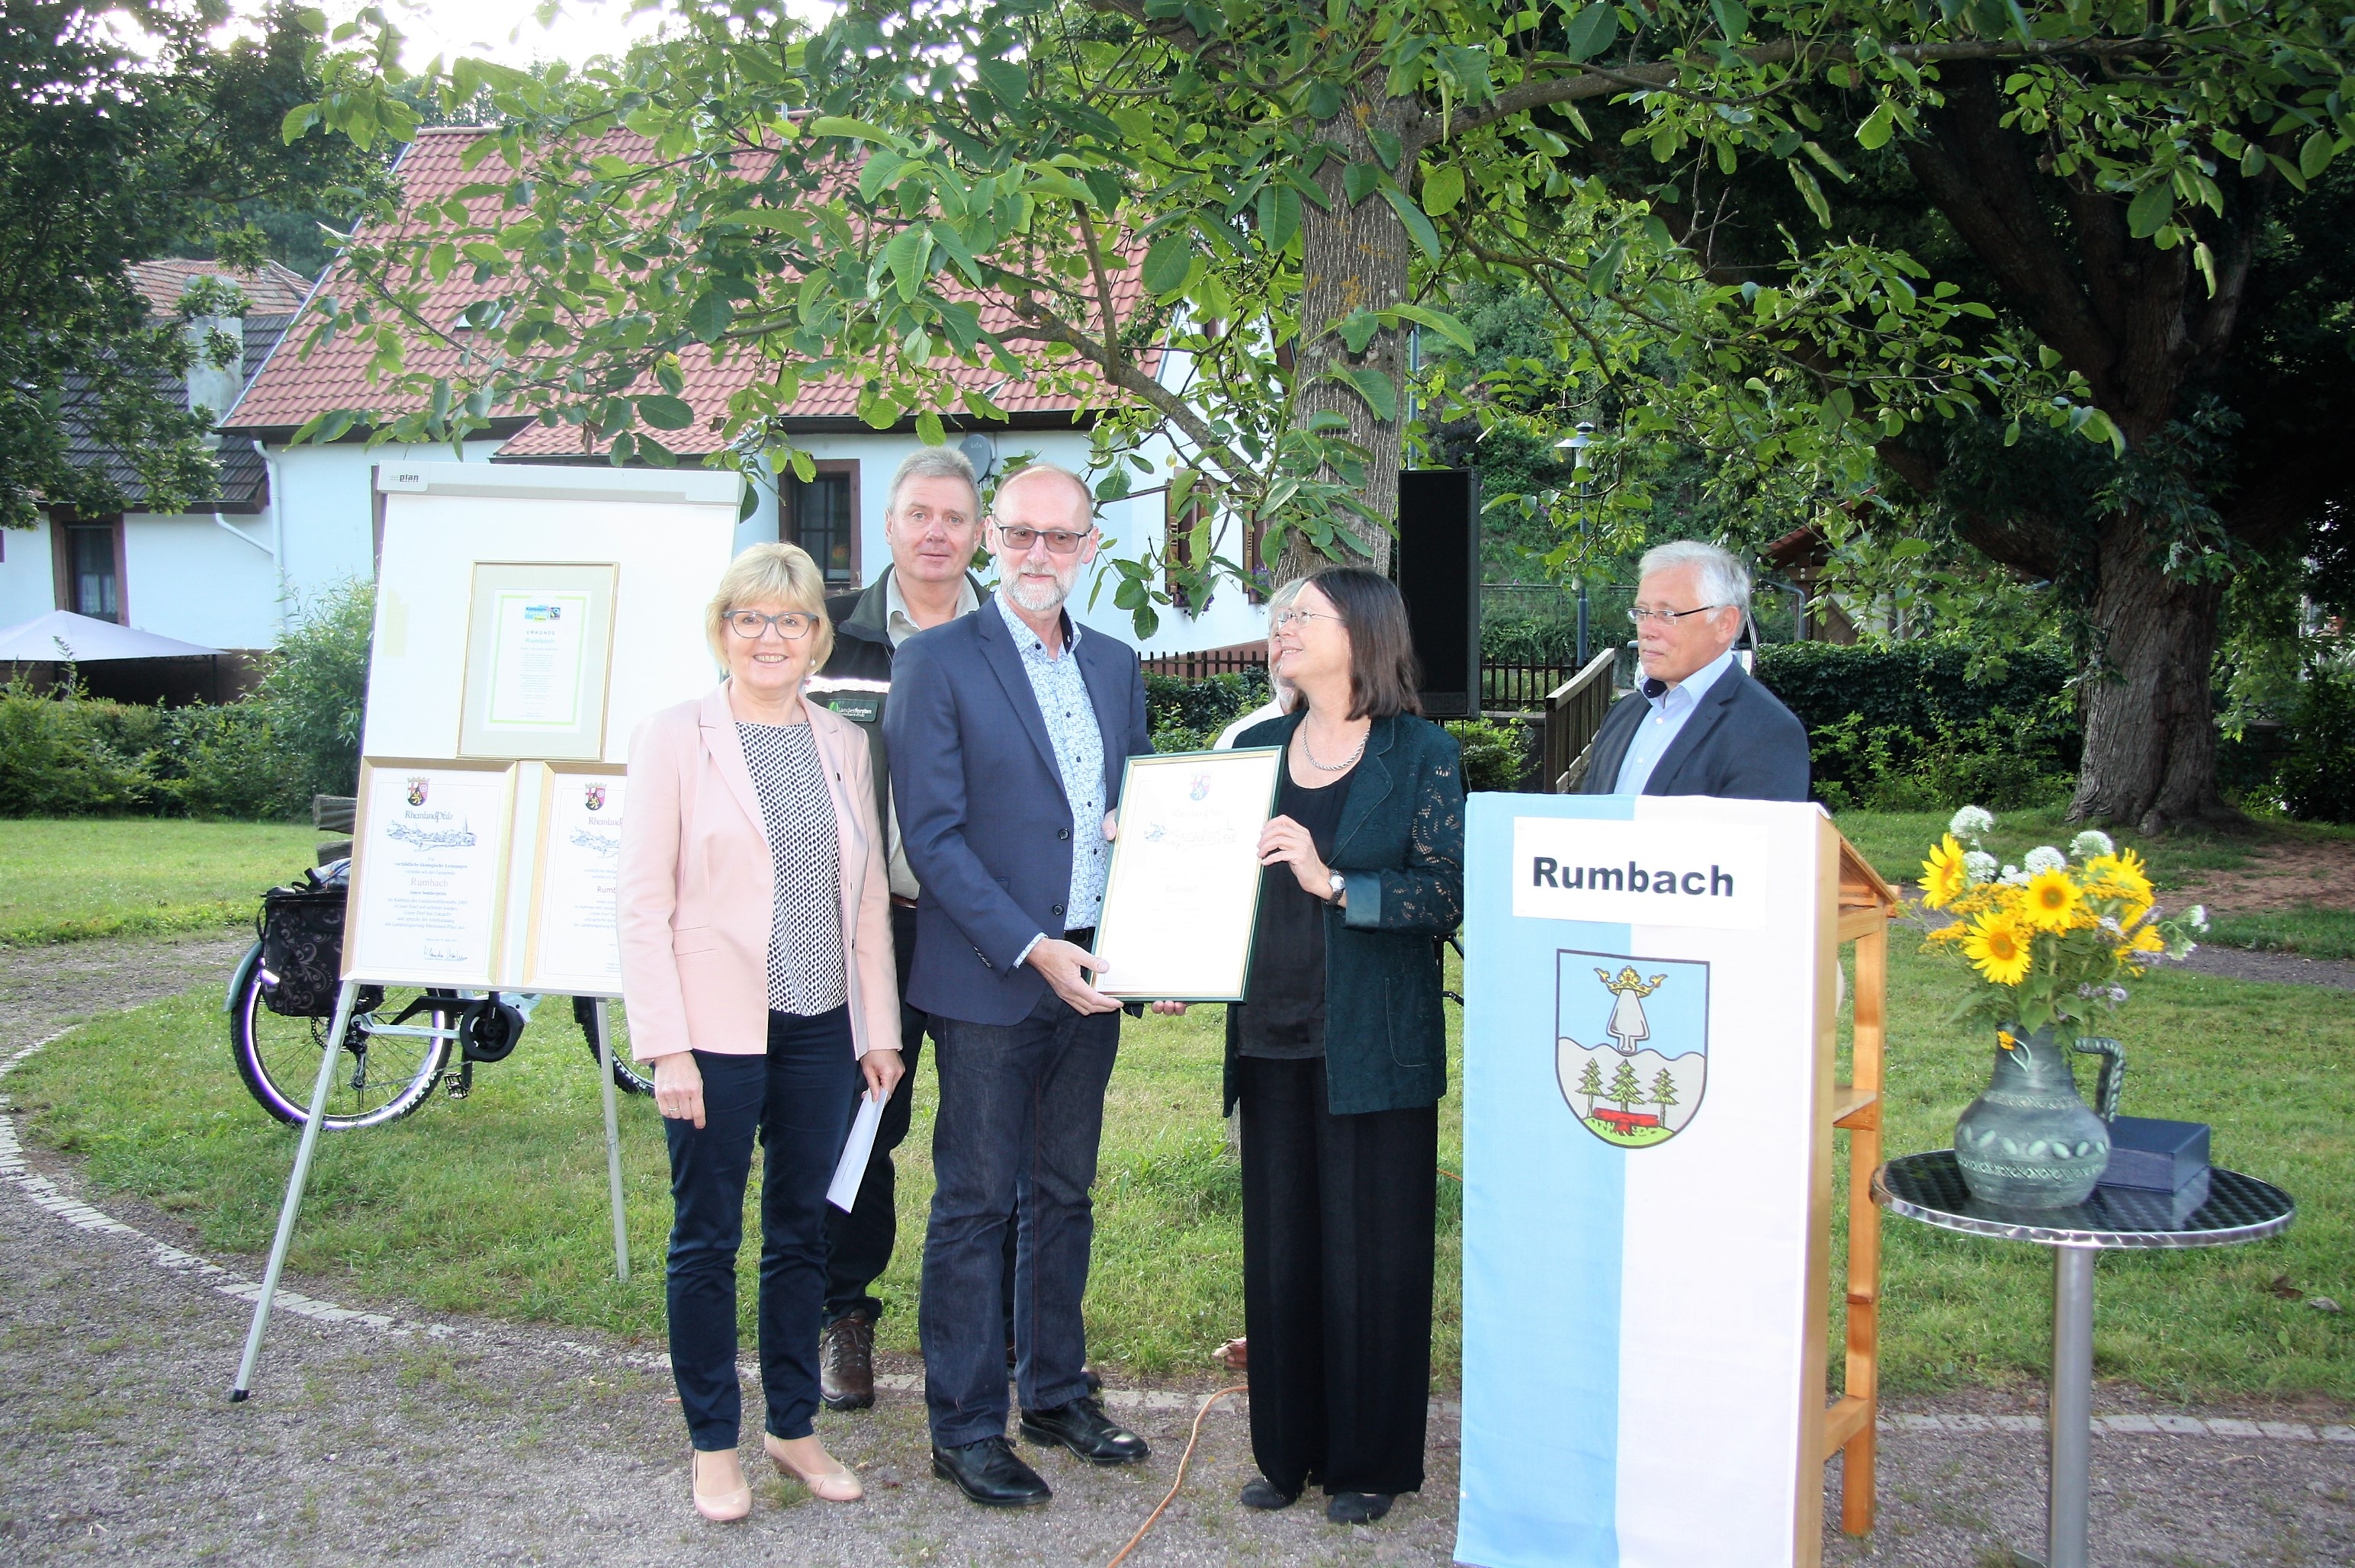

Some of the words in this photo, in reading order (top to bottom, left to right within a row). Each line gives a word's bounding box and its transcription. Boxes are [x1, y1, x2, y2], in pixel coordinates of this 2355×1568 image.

[400, 474, 419, 482] plan
[410, 877, 448, 887] Rumbach
[1533, 856, 1734, 898] Rumbach
[612, 1056, 647, 1089] MAXXIS
[399, 1071, 438, 1114] MAXXIS
